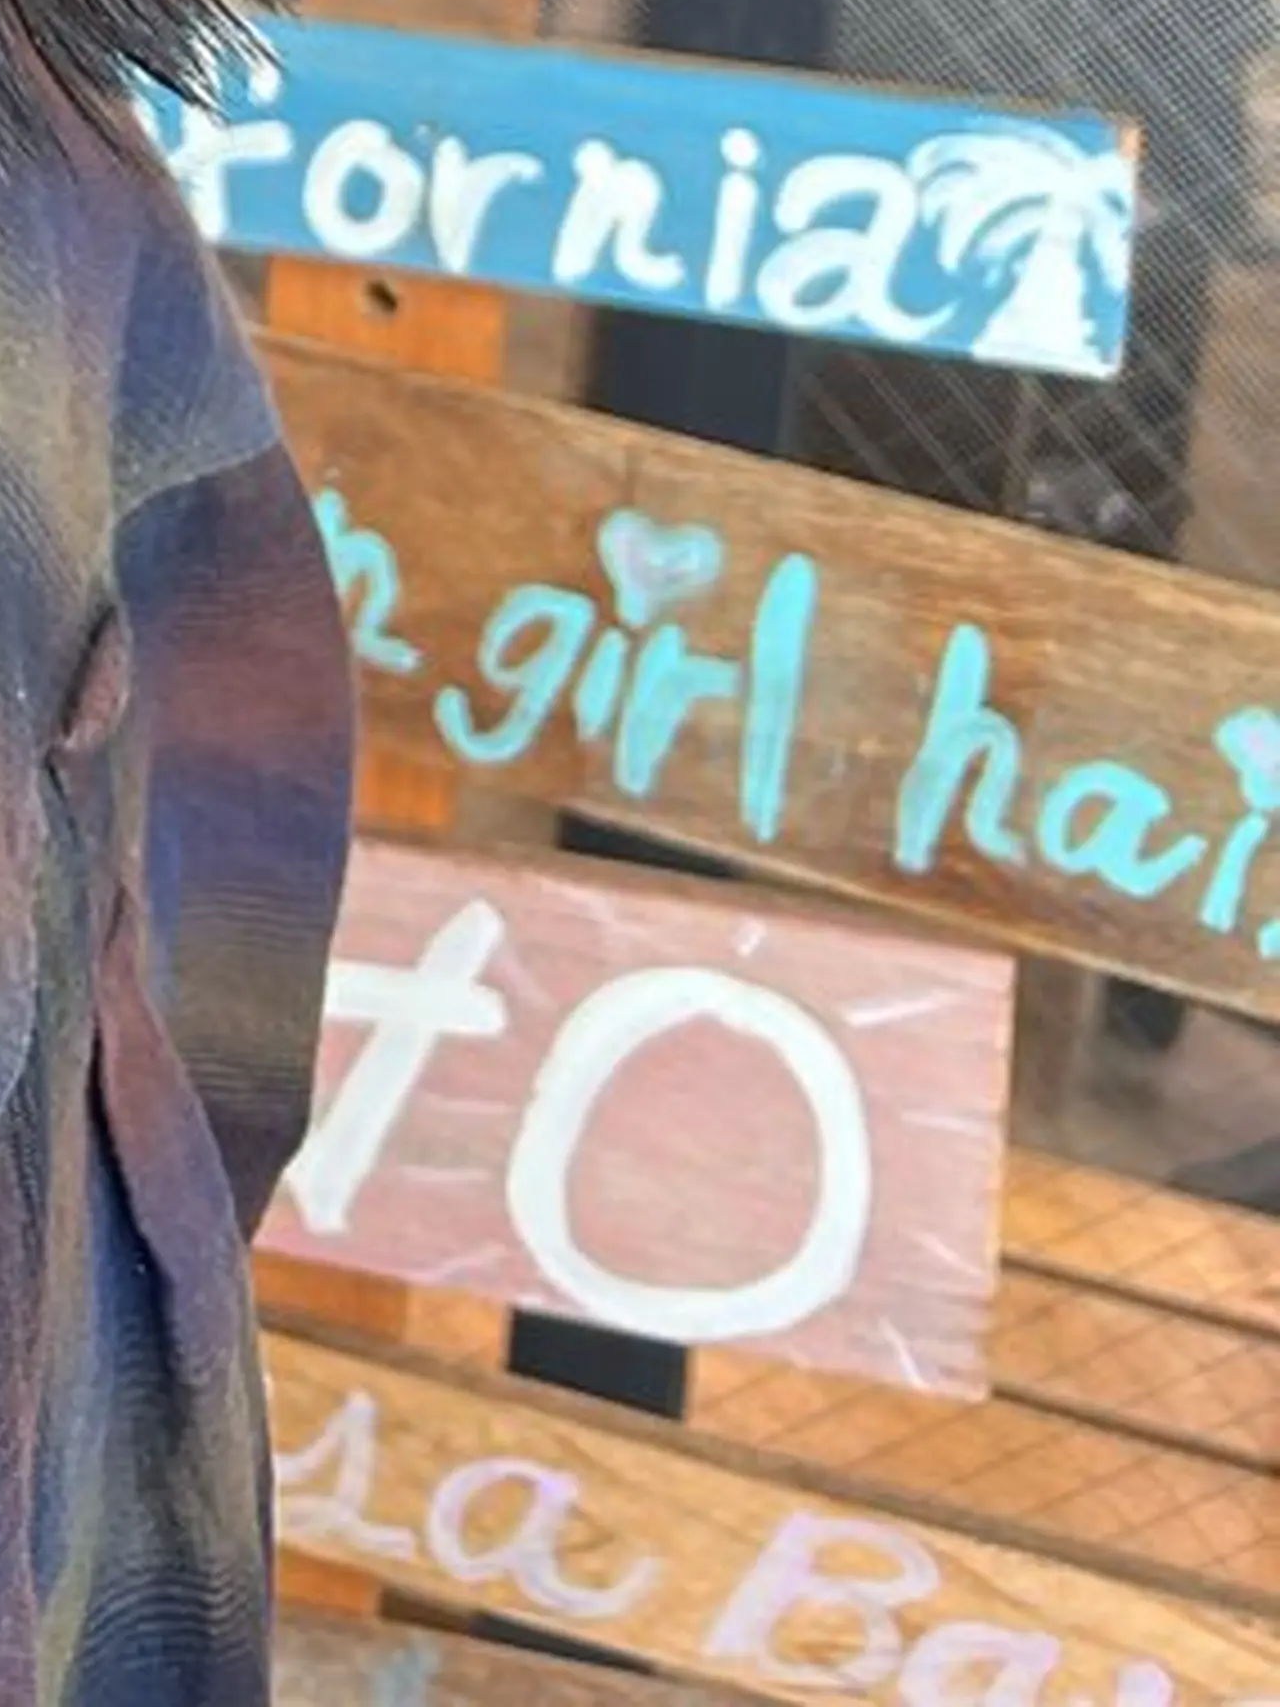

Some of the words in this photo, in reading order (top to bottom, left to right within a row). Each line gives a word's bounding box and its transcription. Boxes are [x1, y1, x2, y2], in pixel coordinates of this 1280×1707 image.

[132, 25, 955, 343] fornia
[436, 511, 818, 841] girl
[895, 622, 1280, 960] hai
